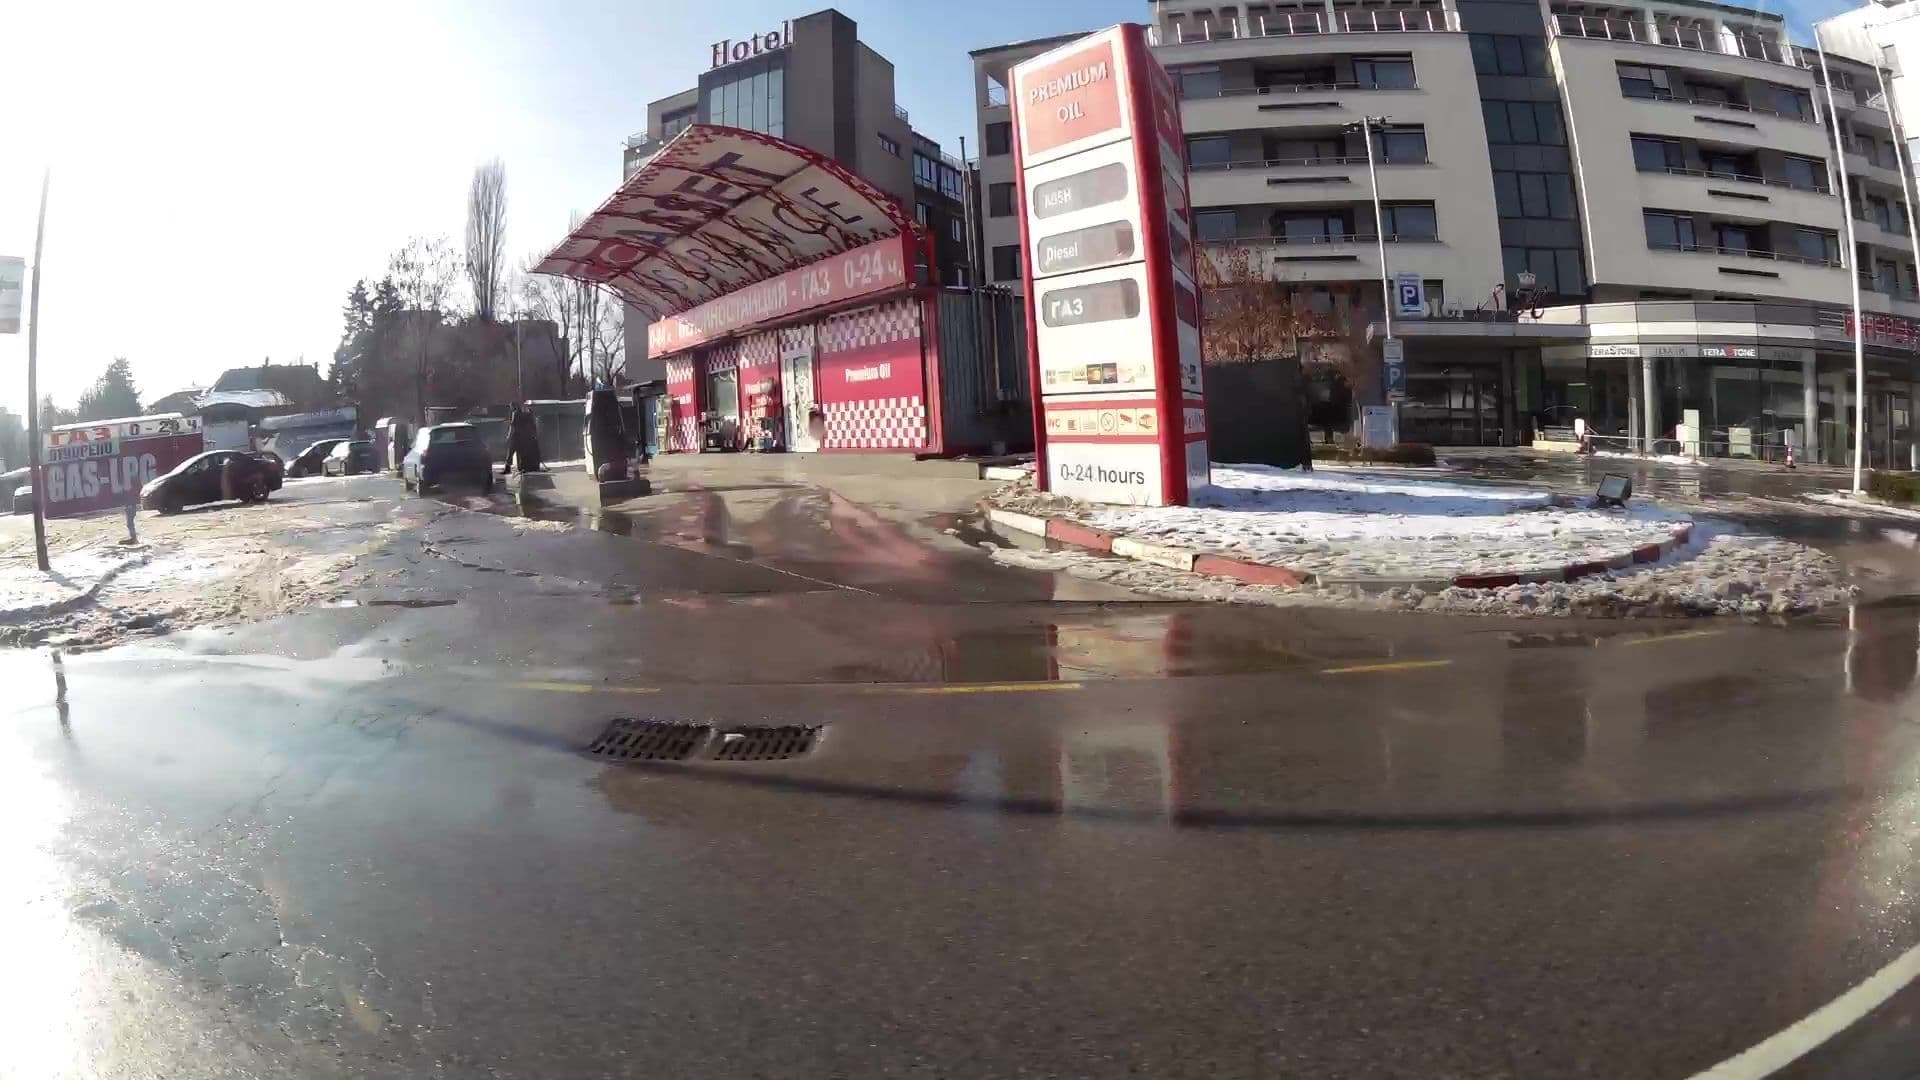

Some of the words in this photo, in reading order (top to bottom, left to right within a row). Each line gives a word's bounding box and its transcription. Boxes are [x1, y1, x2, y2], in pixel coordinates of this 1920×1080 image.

[710, 20, 793, 69] Hotel
[1031, 62, 1108, 105] PREMIUM
[1057, 102, 1085, 124] OIL
[1046, 242, 1078, 267] Diesel
[802, 270, 830, 299] ГАЗ
[844, 250, 884, 288] 0-24
[1051, 299, 1084, 320] ГАЗ
[49, 453, 157, 502] GAS-LPG
[1060, 463, 1093, 481] 0-24
[1097, 465, 1145, 485] hours
